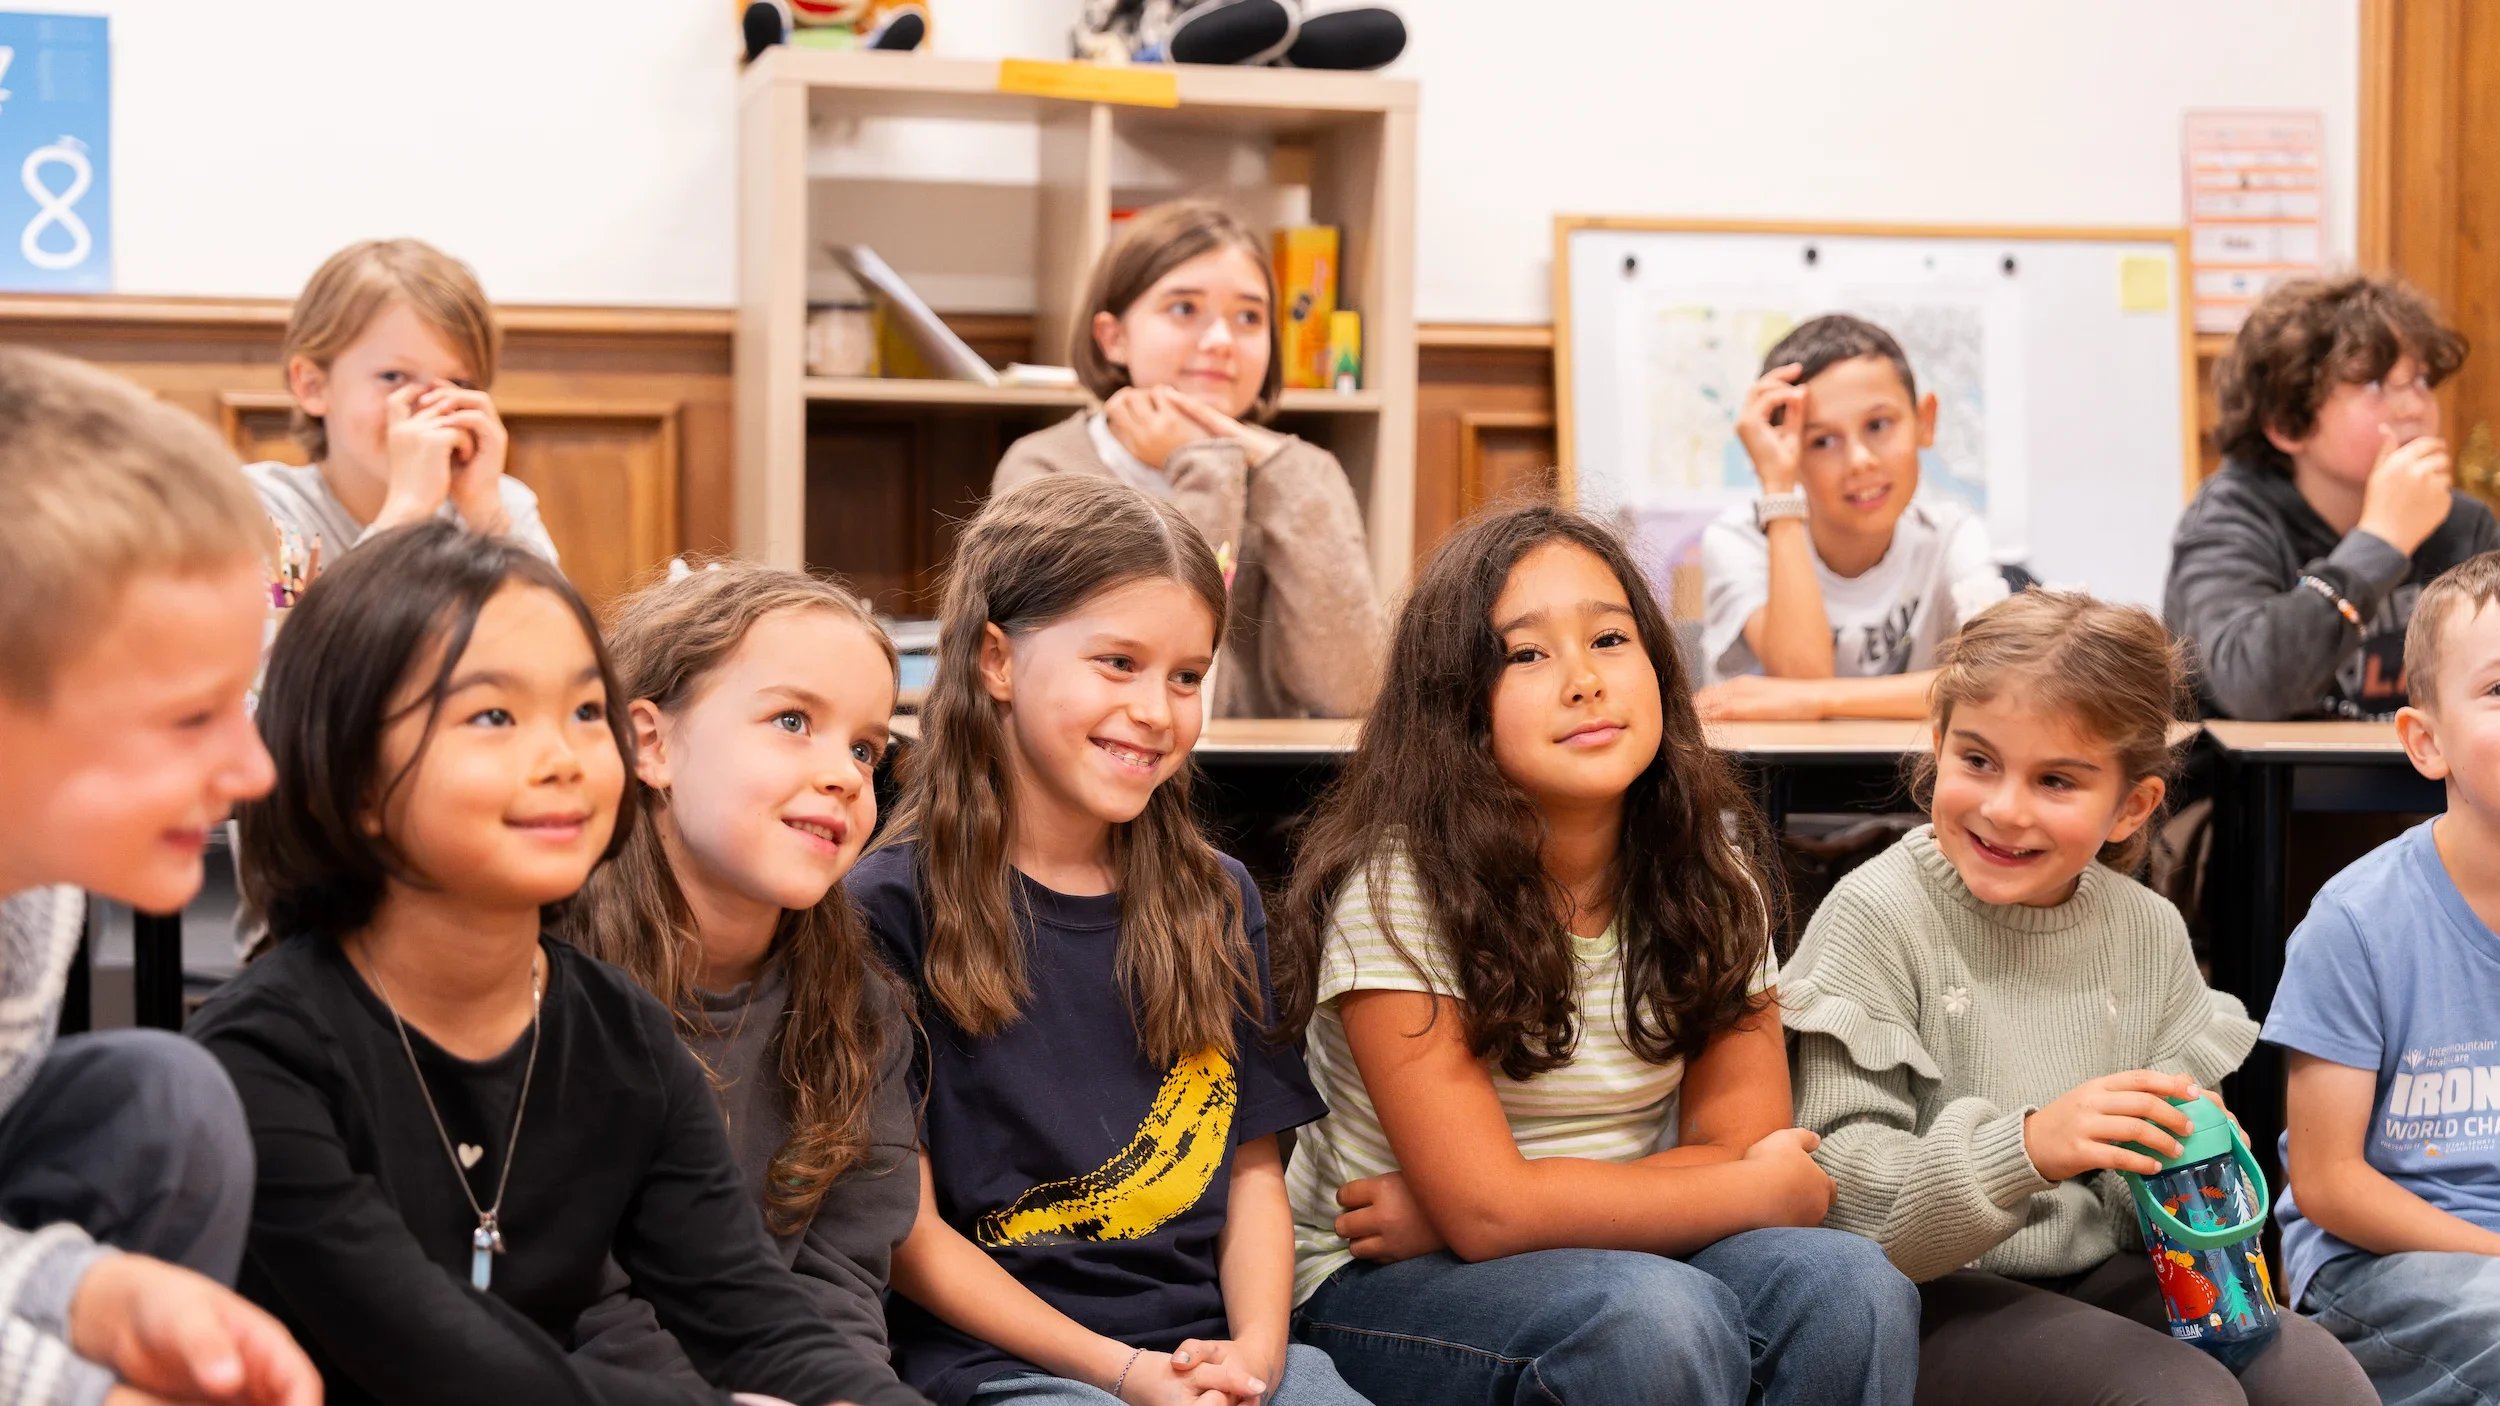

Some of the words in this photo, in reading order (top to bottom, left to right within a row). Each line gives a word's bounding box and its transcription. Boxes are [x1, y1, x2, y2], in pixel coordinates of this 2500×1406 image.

[21, 144, 93, 270] 8
[2429, 1039, 2494, 1056] Intemountain
[2389, 1065, 2500, 1117] IRON
[2385, 1118, 2458, 1140] WORLD
